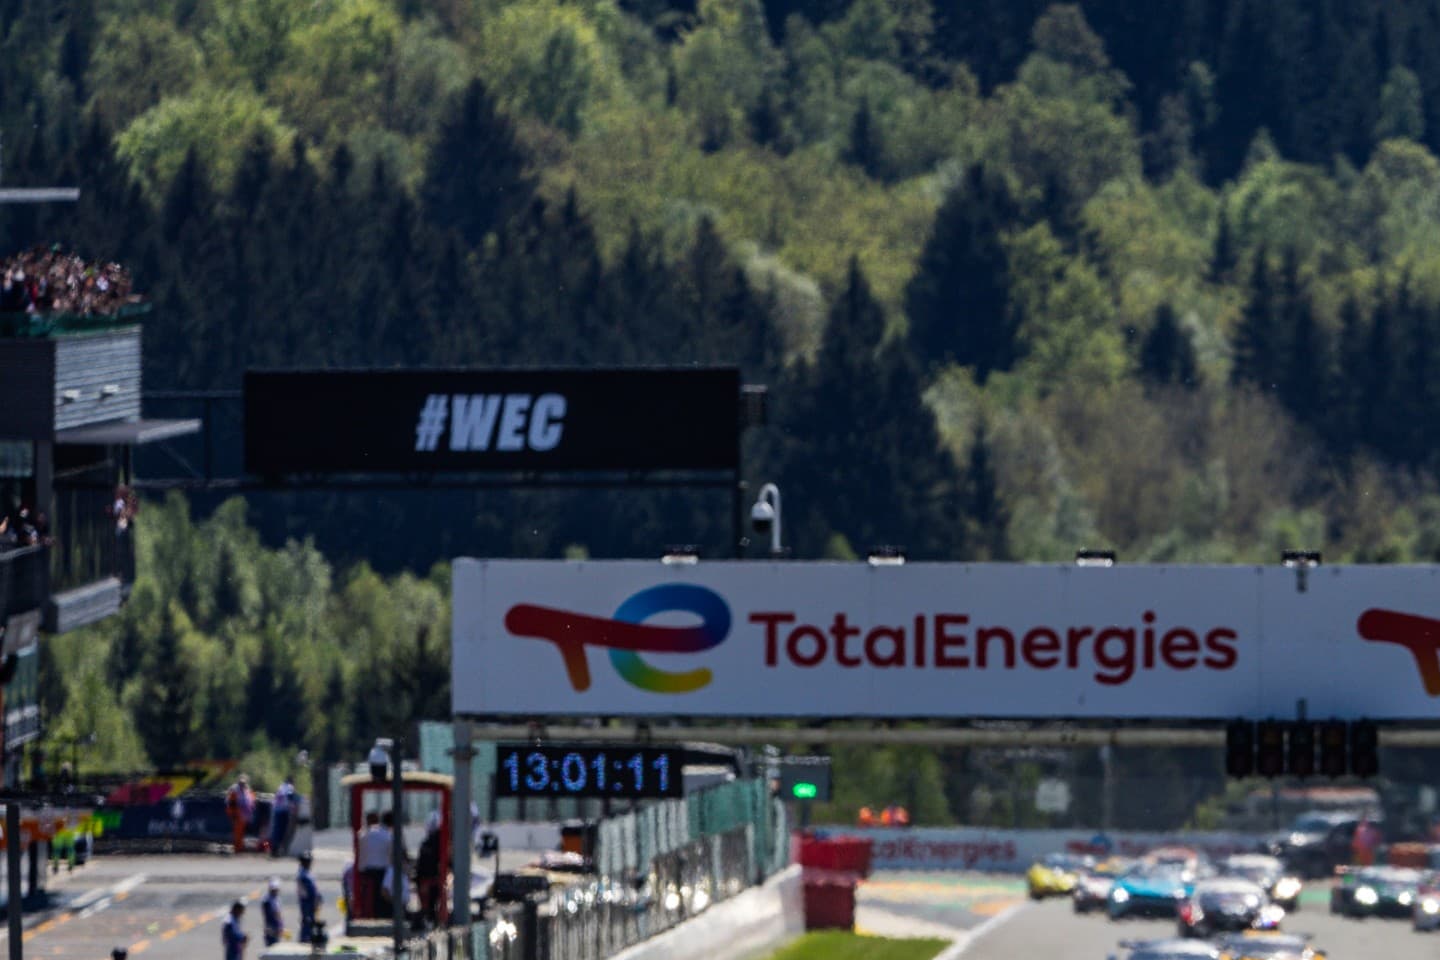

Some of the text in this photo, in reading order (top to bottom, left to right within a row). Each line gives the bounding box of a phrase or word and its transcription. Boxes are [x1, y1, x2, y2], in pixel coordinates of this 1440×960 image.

[415, 394, 567, 451] #WEC
[748, 610, 1238, 686] TotalEnergies
[504, 752, 669, 791] 13:01:11
